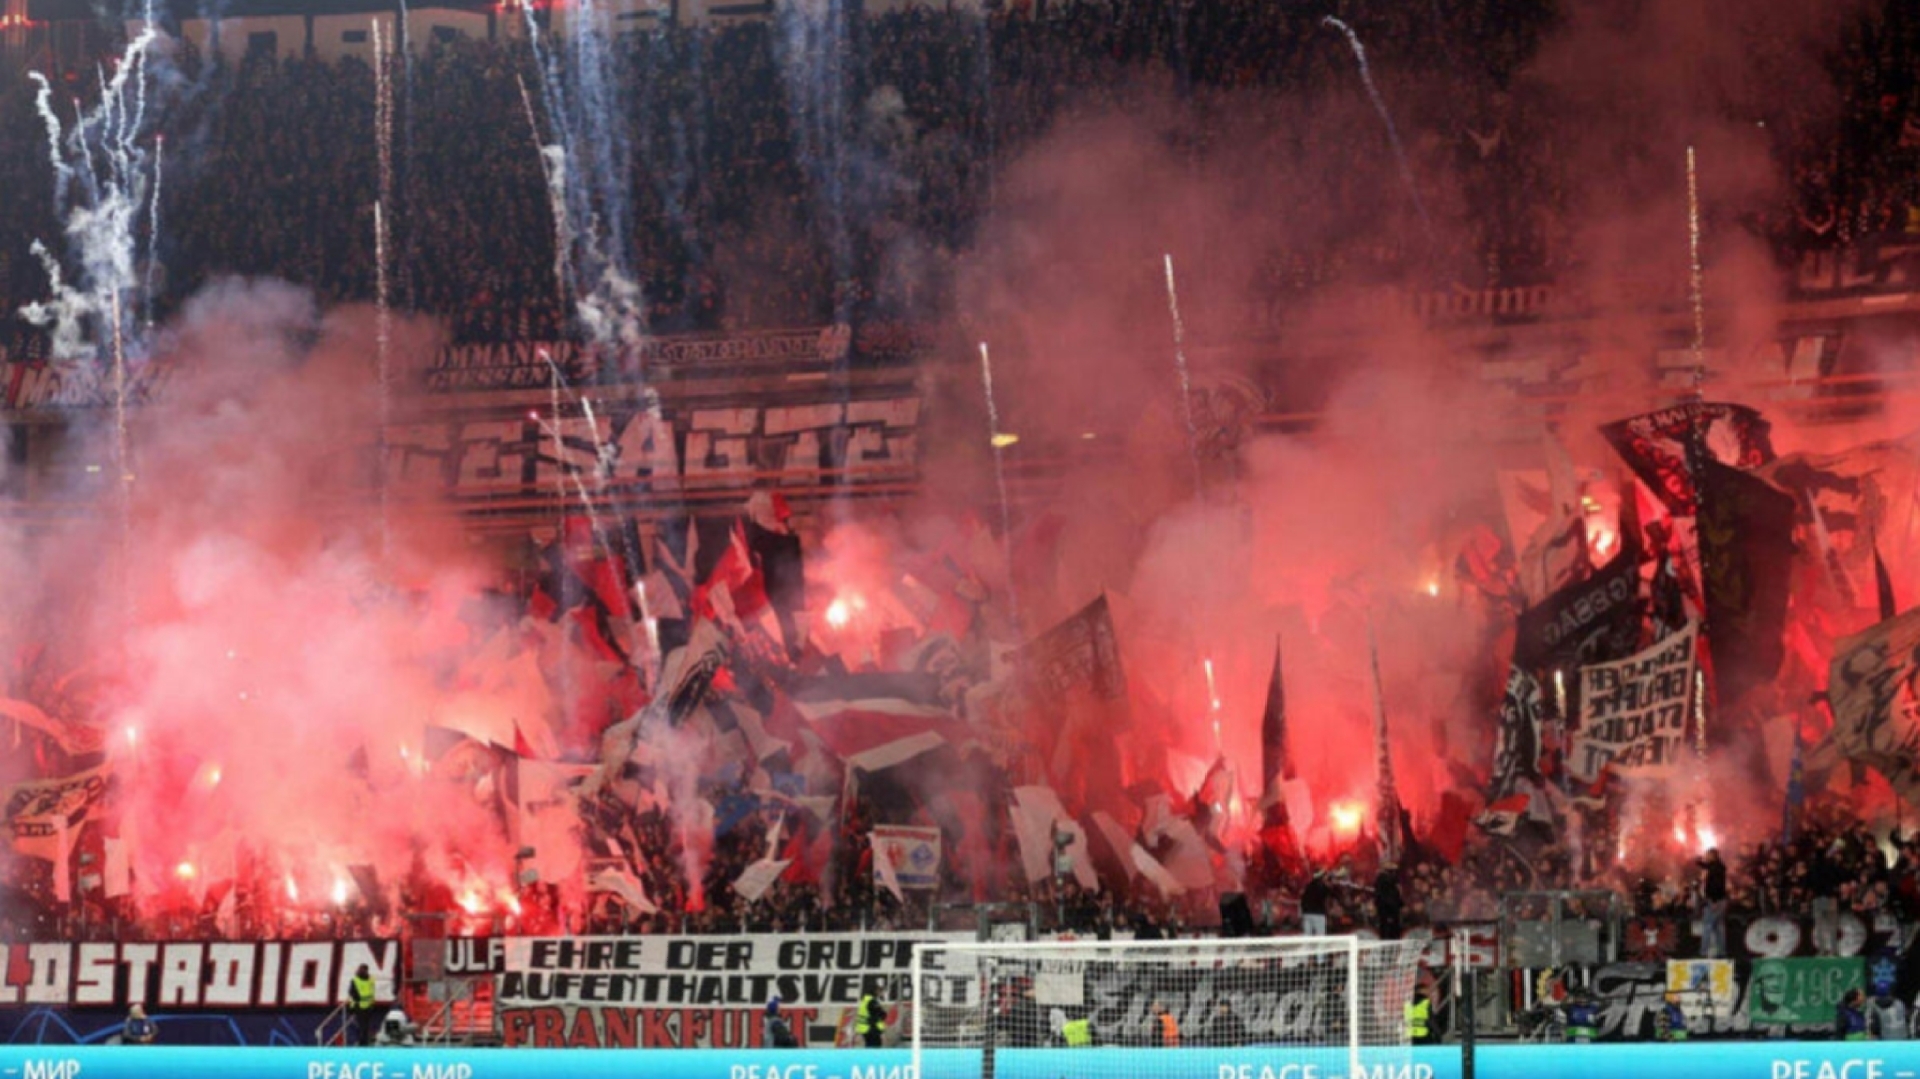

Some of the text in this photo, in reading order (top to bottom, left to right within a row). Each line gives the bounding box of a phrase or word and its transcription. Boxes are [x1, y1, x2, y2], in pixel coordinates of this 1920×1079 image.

[530, 939, 946, 970] EHRE DER GRUPPE
[501, 971, 974, 1003] AUFENTHALTSVERBOT
